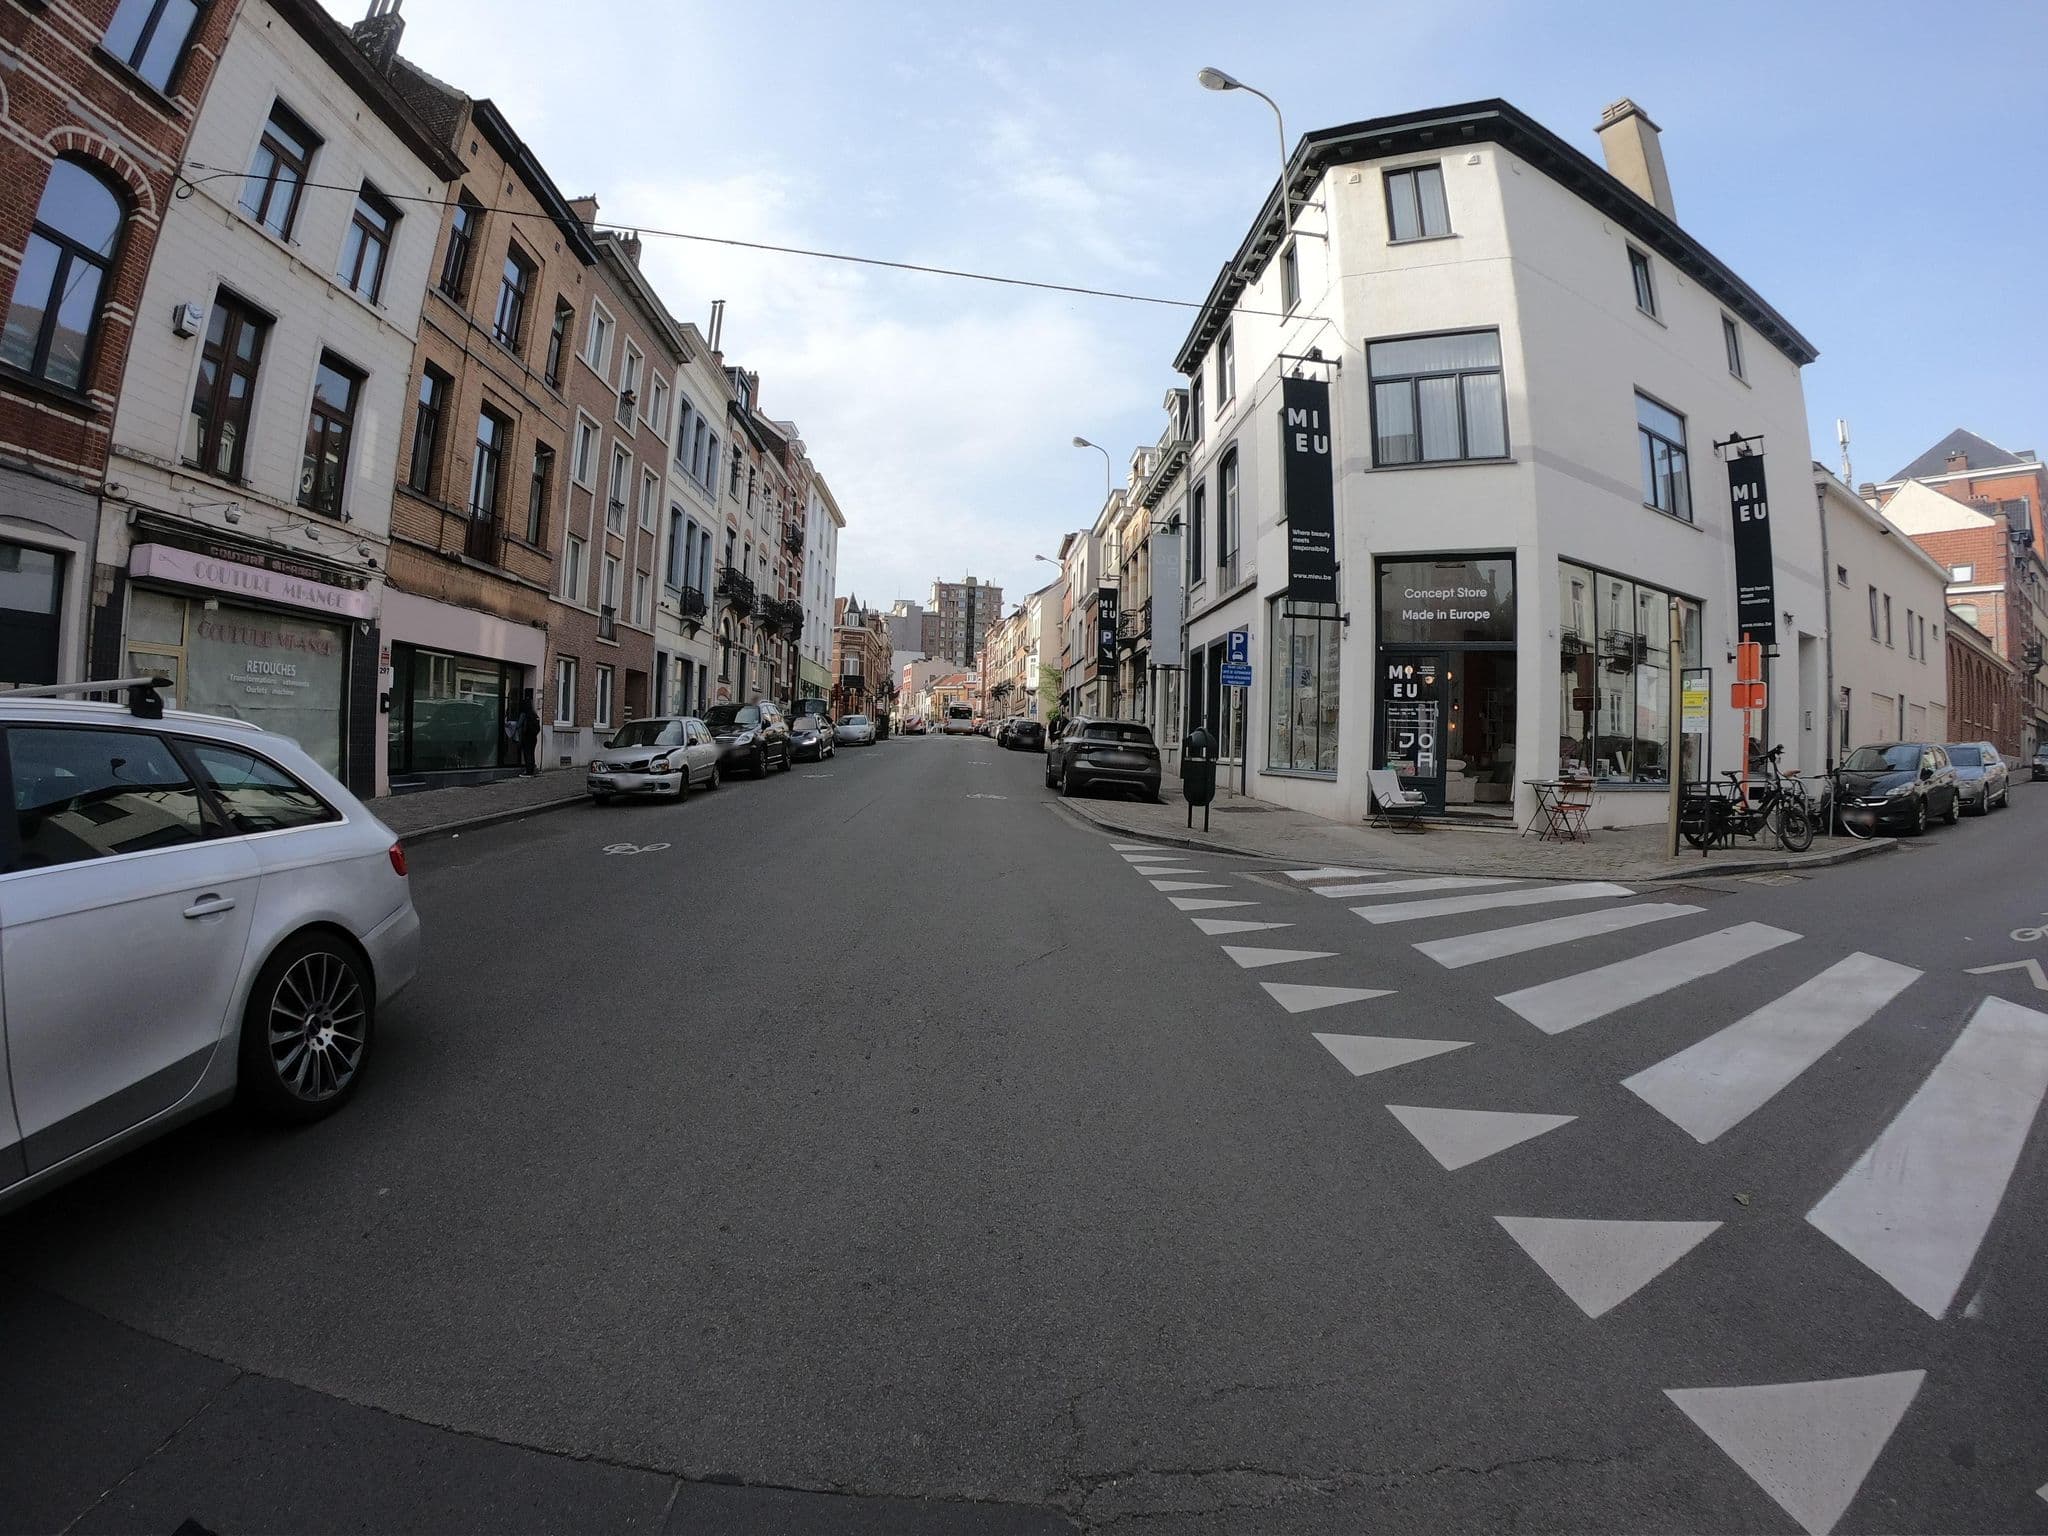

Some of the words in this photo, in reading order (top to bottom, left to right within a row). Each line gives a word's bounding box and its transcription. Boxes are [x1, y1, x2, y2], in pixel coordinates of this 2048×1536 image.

[1287, 407, 1319, 428] MI
[1295, 433, 1329, 455] EU
[1732, 482, 1759, 502] MI
[1739, 503, 1768, 522] EU
[193, 561, 272, 593] COUTURE
[1292, 573, 1332, 581] www.mieu.be
[1404, 588, 1455, 600] Concept
[1457, 587, 1488, 598] Store
[1402, 610, 1434, 620] Made
[1436, 609, 1447, 620] in
[1450, 609, 1491, 622] Europe
[1232, 633, 1245, 651] P
[246, 660, 297, 677] RETOUCHES
[1393, 683, 1418, 698] EU
